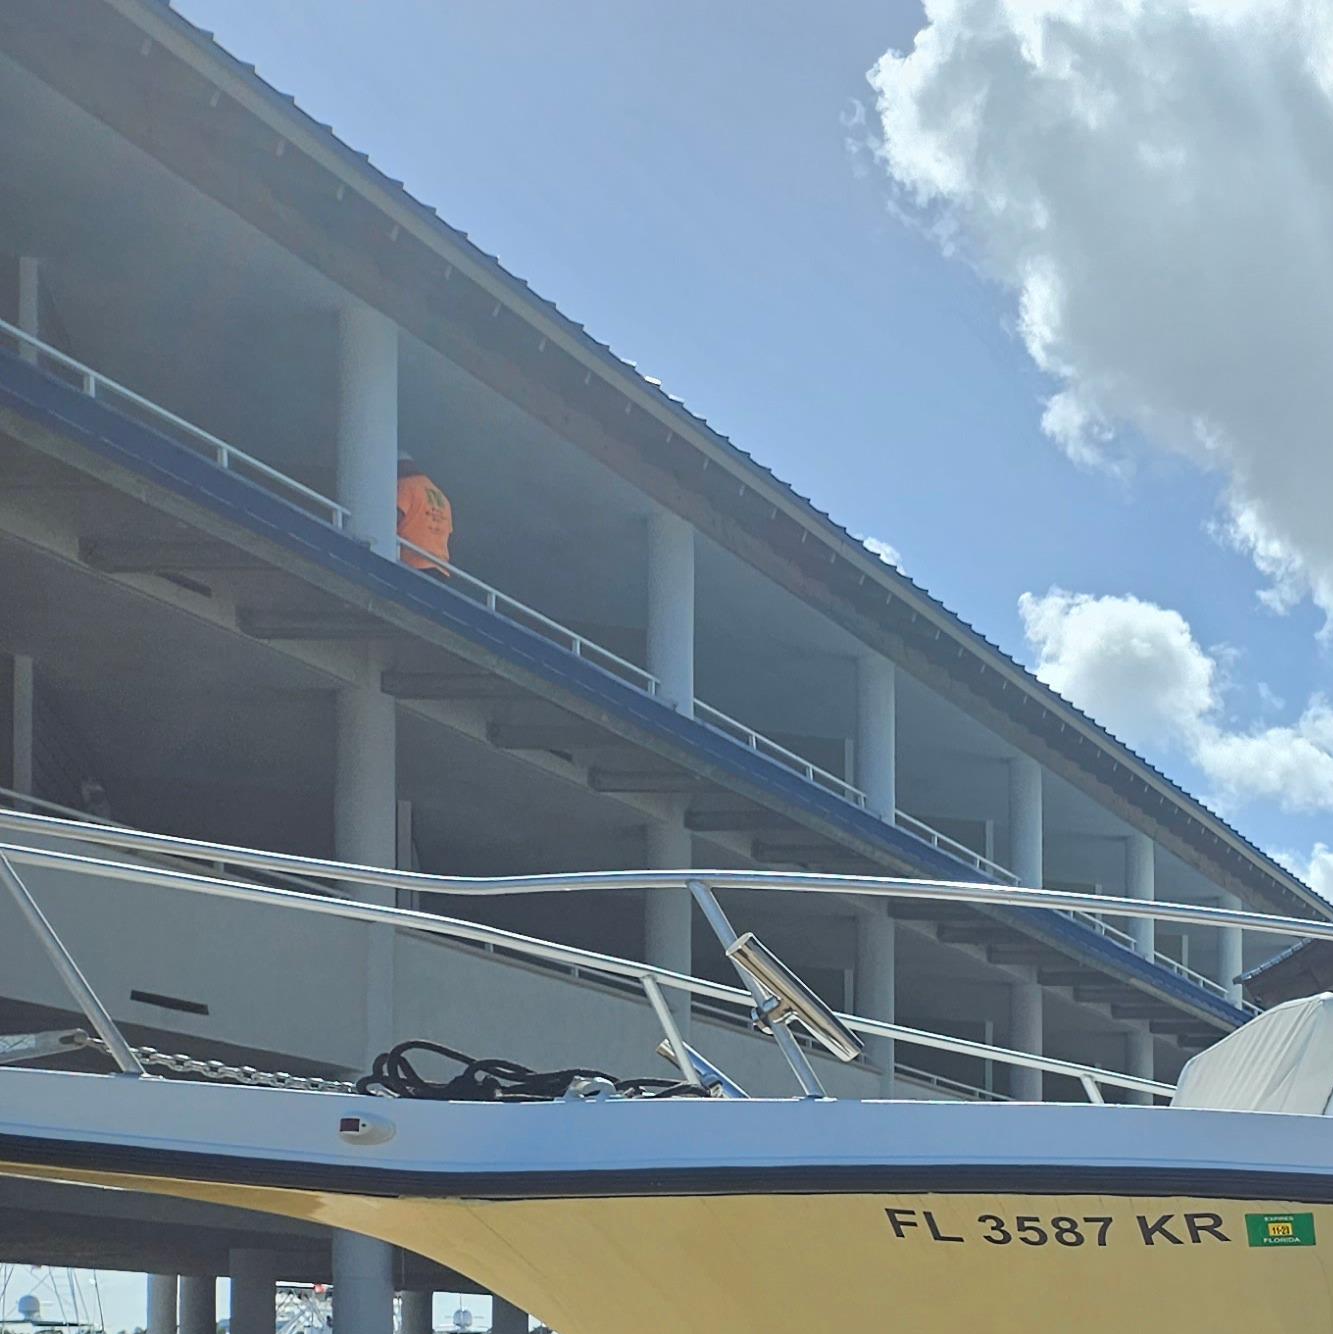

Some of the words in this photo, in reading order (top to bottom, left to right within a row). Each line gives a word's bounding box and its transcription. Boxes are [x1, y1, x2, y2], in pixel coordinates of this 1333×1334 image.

[884, 1207, 965, 1243] FL
[976, 1213, 1114, 1247] 3587
[1136, 1212, 1233, 1246] KR
